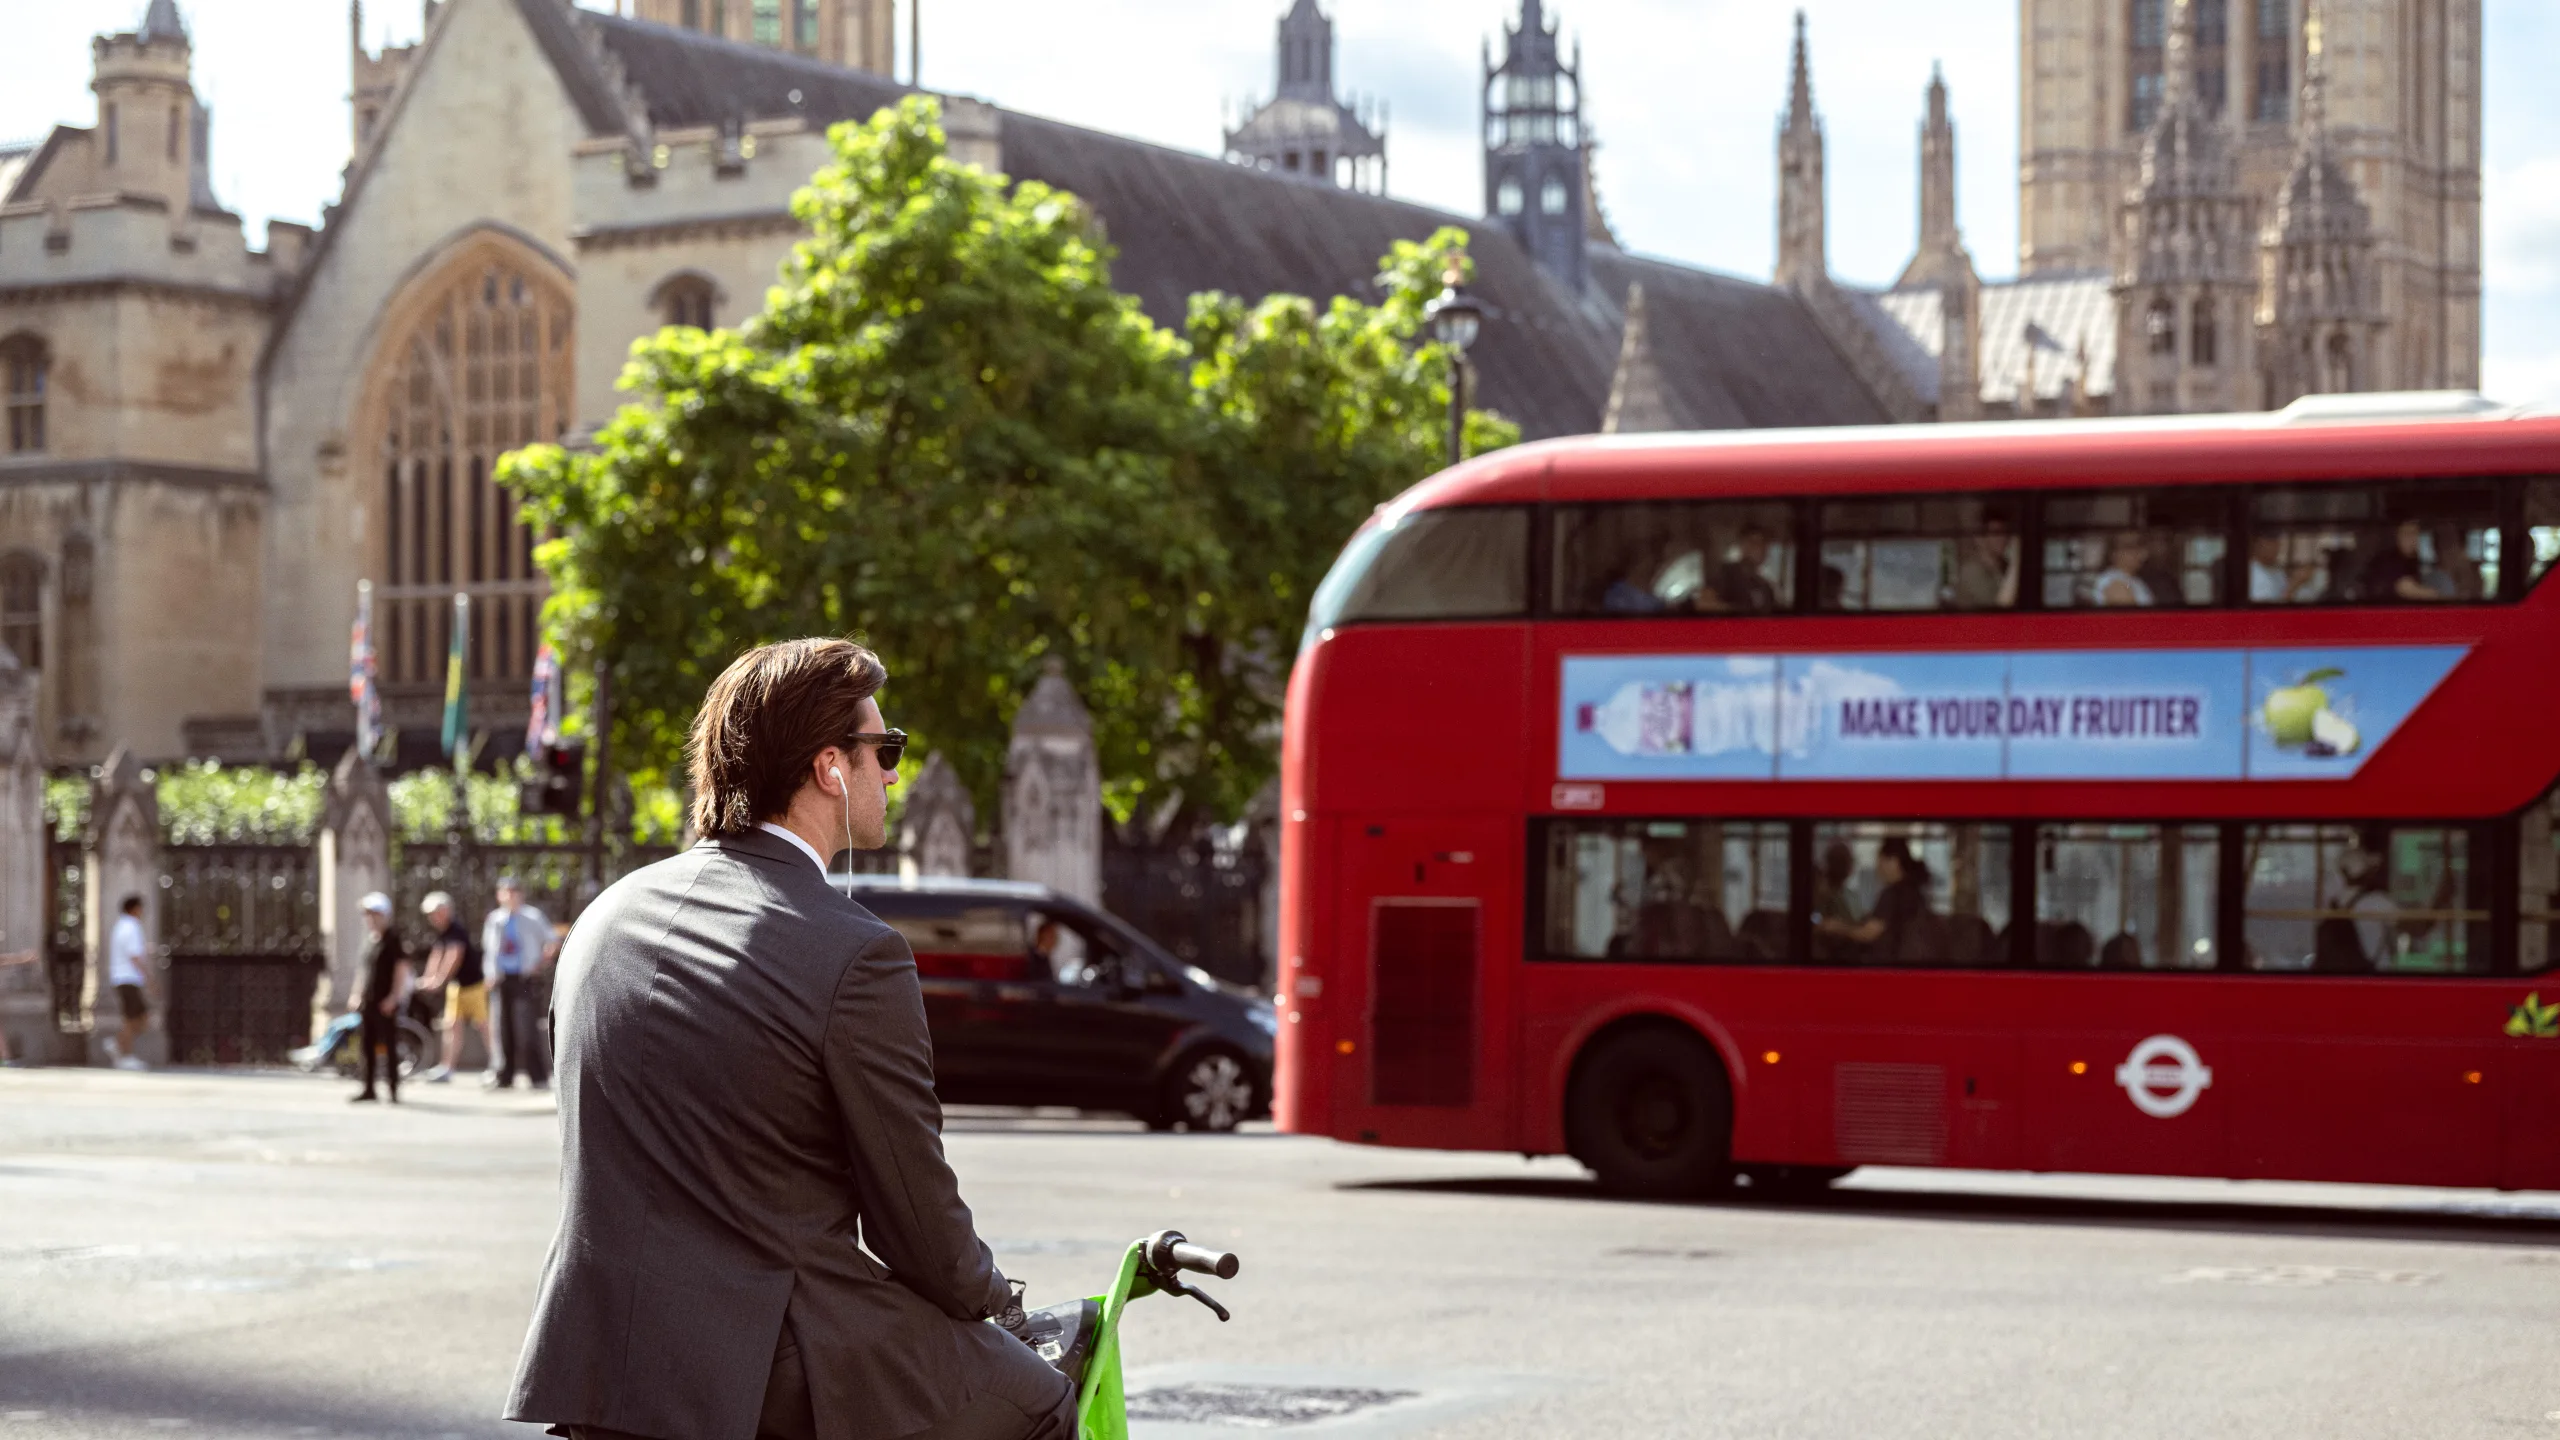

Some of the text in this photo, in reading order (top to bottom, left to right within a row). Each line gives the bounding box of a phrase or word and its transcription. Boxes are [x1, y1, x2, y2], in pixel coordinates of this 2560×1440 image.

[1840, 697, 2199, 738] MAKE YOUR DAY FRUITIER
